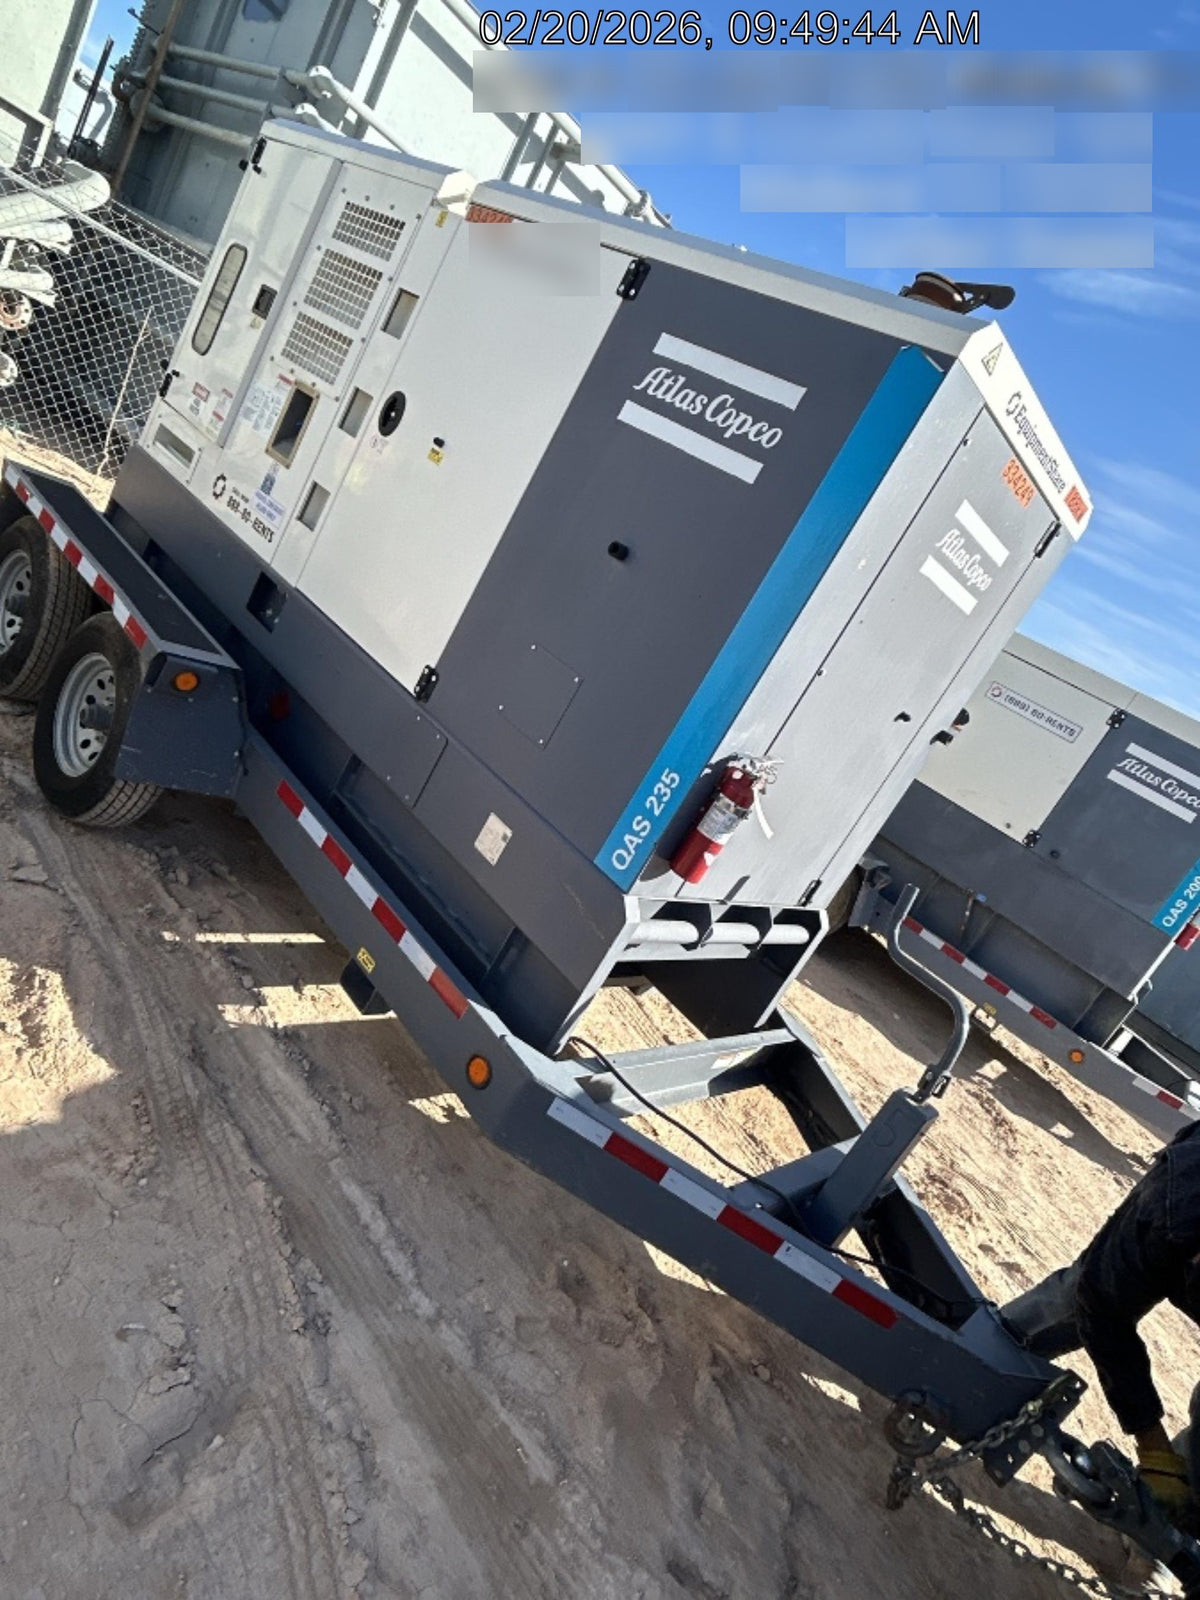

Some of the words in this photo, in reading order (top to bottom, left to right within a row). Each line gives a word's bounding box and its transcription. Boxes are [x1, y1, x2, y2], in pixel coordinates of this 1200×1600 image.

[632, 367, 709, 415] Atlas
[705, 394, 783, 448] Copco
[1013, 406, 1067, 493] EquipmentShare
[935, 528, 970, 569] Atlas
[963, 553, 993, 591] Copco
[1116, 758, 1163, 786] Atlas
[611, 815, 652, 870] QAS
[645, 767, 680, 817] 235
[1161, 898, 1188, 928] QAS
